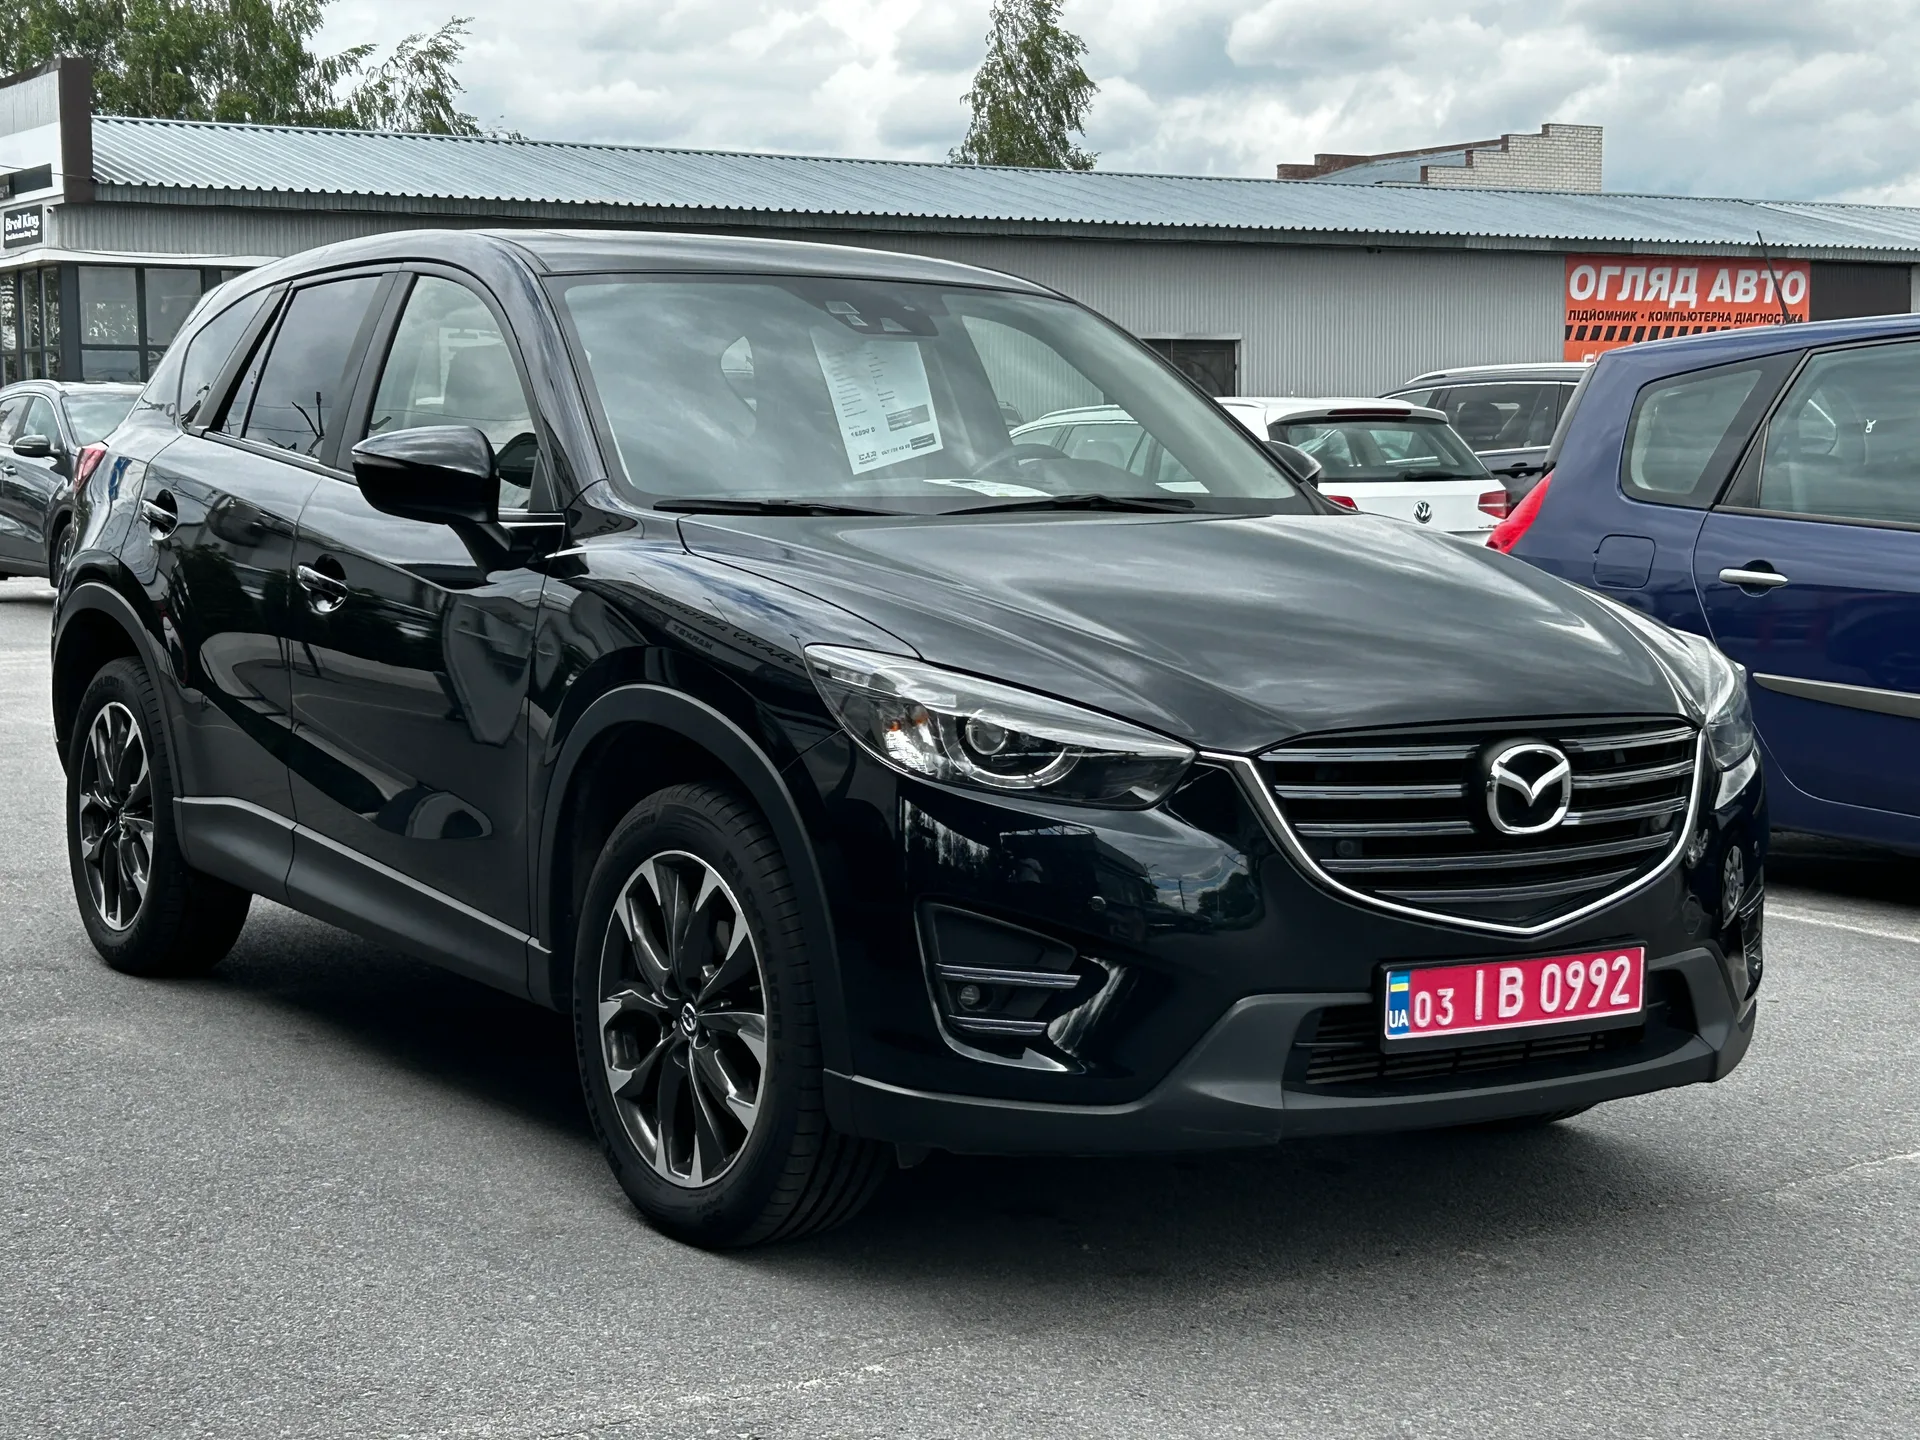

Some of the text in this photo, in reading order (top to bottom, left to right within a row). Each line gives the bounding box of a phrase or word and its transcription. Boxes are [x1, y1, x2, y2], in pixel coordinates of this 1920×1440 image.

[1569, 265, 1806, 309] ОГЛЯД АВТО
[1567, 309, 1804, 325] ПІДЙОМНИК КОМПЬЮТЕРНА ДІАГНОСТКА
[1413, 988, 1455, 1028] 03
[1539, 955, 1631, 1013] 0992
[1388, 1009, 1409, 1028] UA
